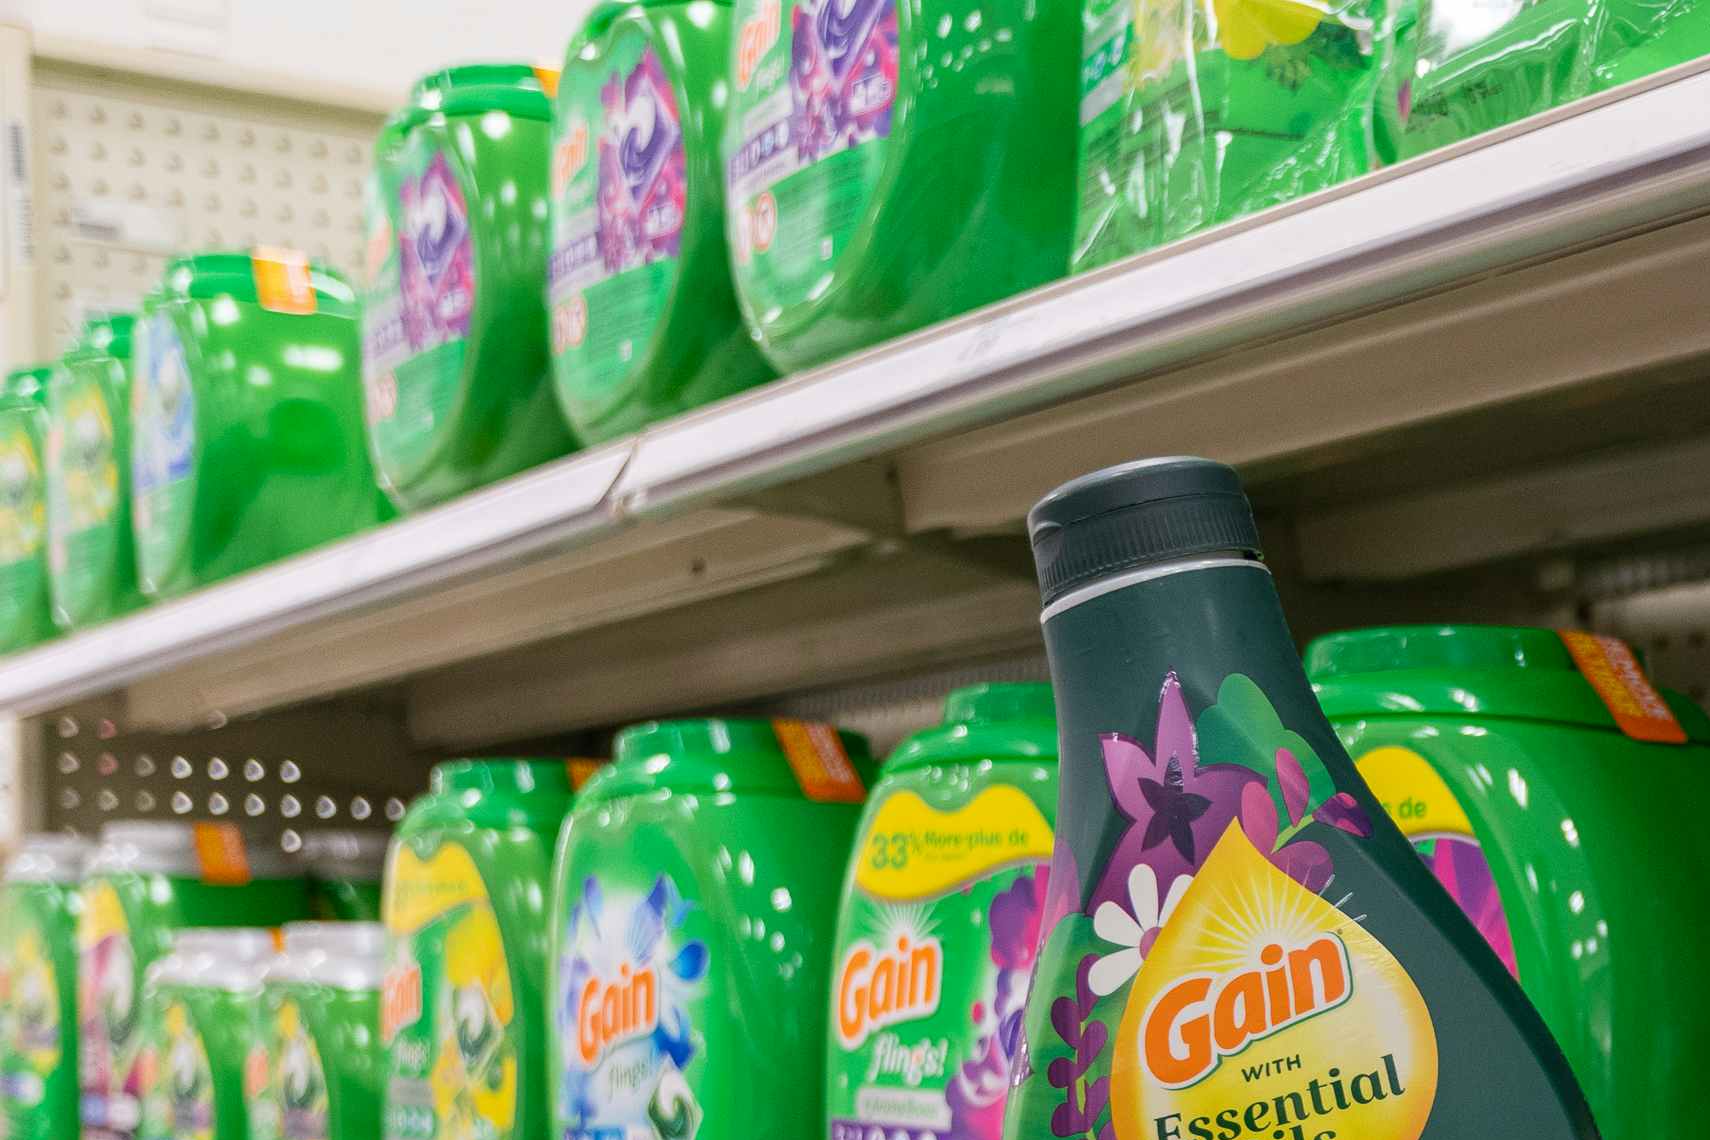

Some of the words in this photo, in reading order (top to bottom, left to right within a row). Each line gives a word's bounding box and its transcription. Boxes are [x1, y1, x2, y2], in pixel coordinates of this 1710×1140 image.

[579, 963, 655, 1063] Gain
[840, 935, 937, 1038] Gain
[1144, 943, 1346, 1085] Gain
[1242, 1054, 1301, 1082] WITH
